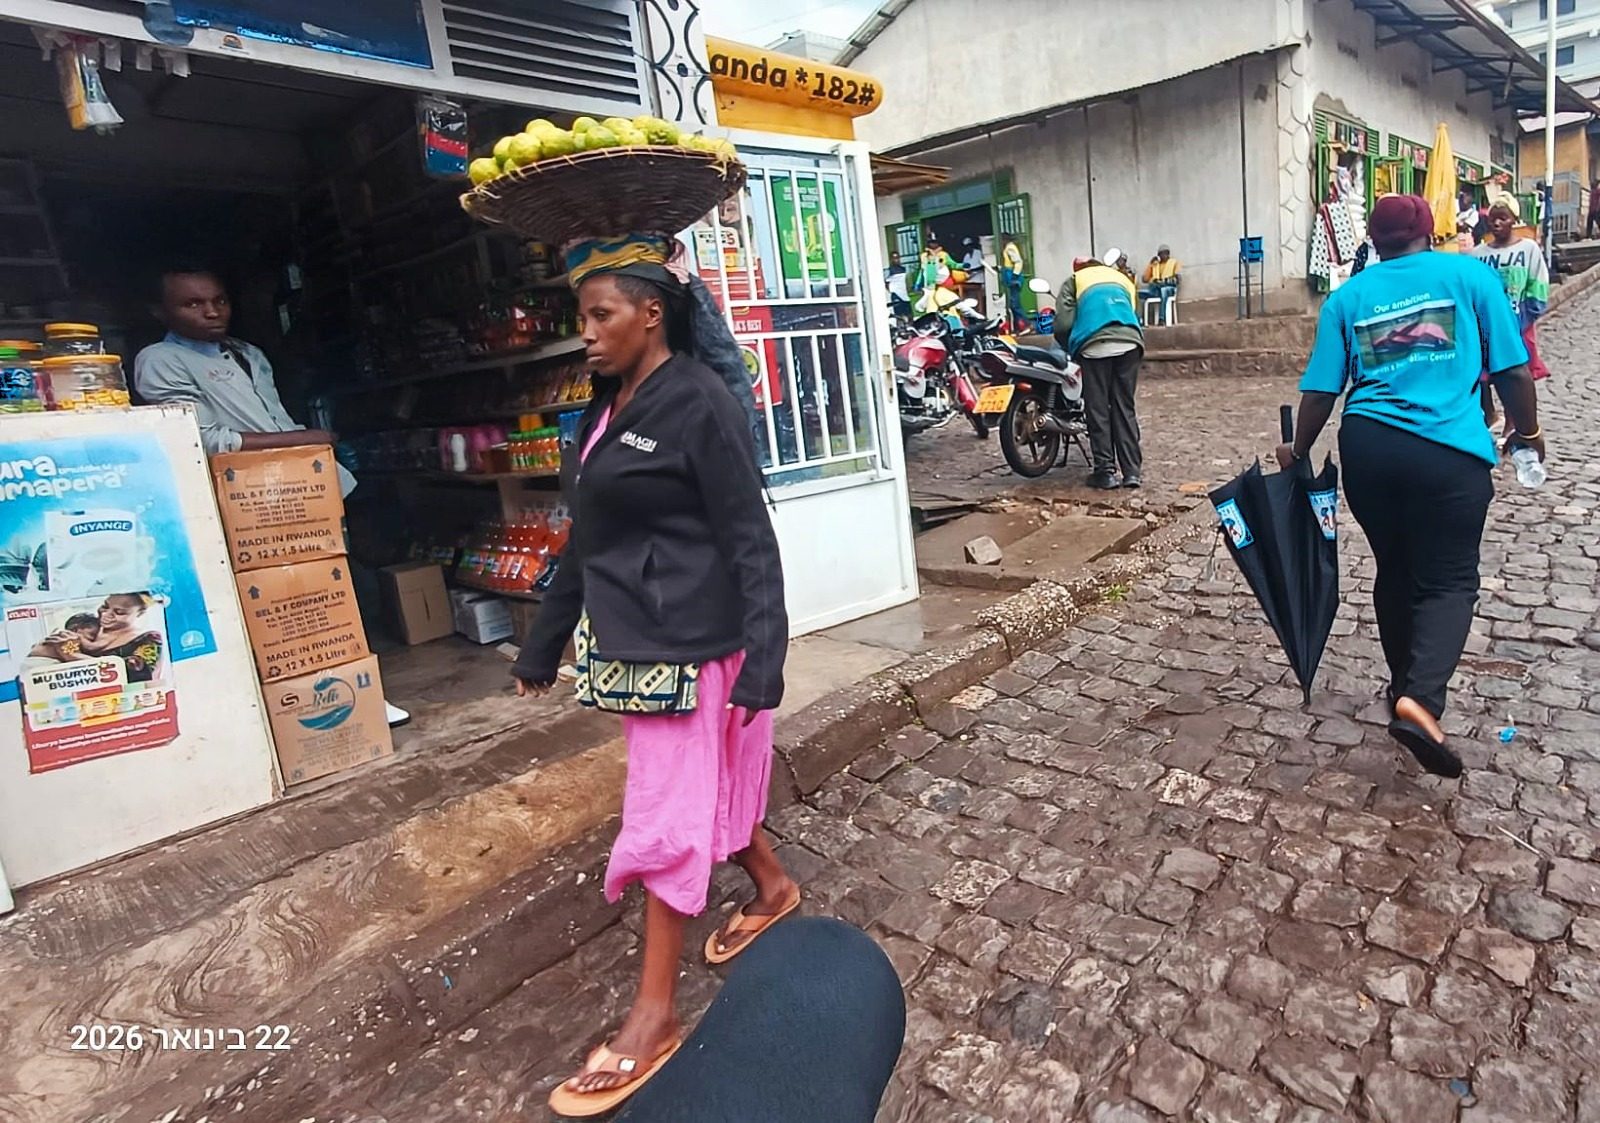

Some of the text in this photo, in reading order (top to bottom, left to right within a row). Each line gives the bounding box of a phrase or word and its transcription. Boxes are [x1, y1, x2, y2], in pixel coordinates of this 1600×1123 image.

[710, 54, 787, 88] anda
[1478, 251, 1526, 269] INJA
[1374, 304, 1390, 314] Our
[266, 486, 308, 496] COMPANY
[310, 484, 326, 492] LTD
[73, 521, 130, 534] INYANGE
[238, 537, 270, 548] MADE
[272, 535, 284, 543] IN
[286, 528, 332, 541] RWANDA
[257, 550, 269, 560] 12
[282, 545, 297, 555] 1.5
[255, 608, 272, 618] BEL
[283, 603, 288, 611] F
[290, 595, 329, 609] COMPANY
[331, 590, 346, 600] LTD
[266, 650, 297, 663] MADE
[299, 645, 310, 654] IN
[312, 633, 356, 651] RWANDA
[286, 662, 297, 671] 12
[309, 654, 323, 664] 1.5
[325, 649, 347, 660] Litre
[32, 675, 52, 685] MU
[55, 668, 97, 680] BURYO
[49, 677, 98, 690] BUSHYA
